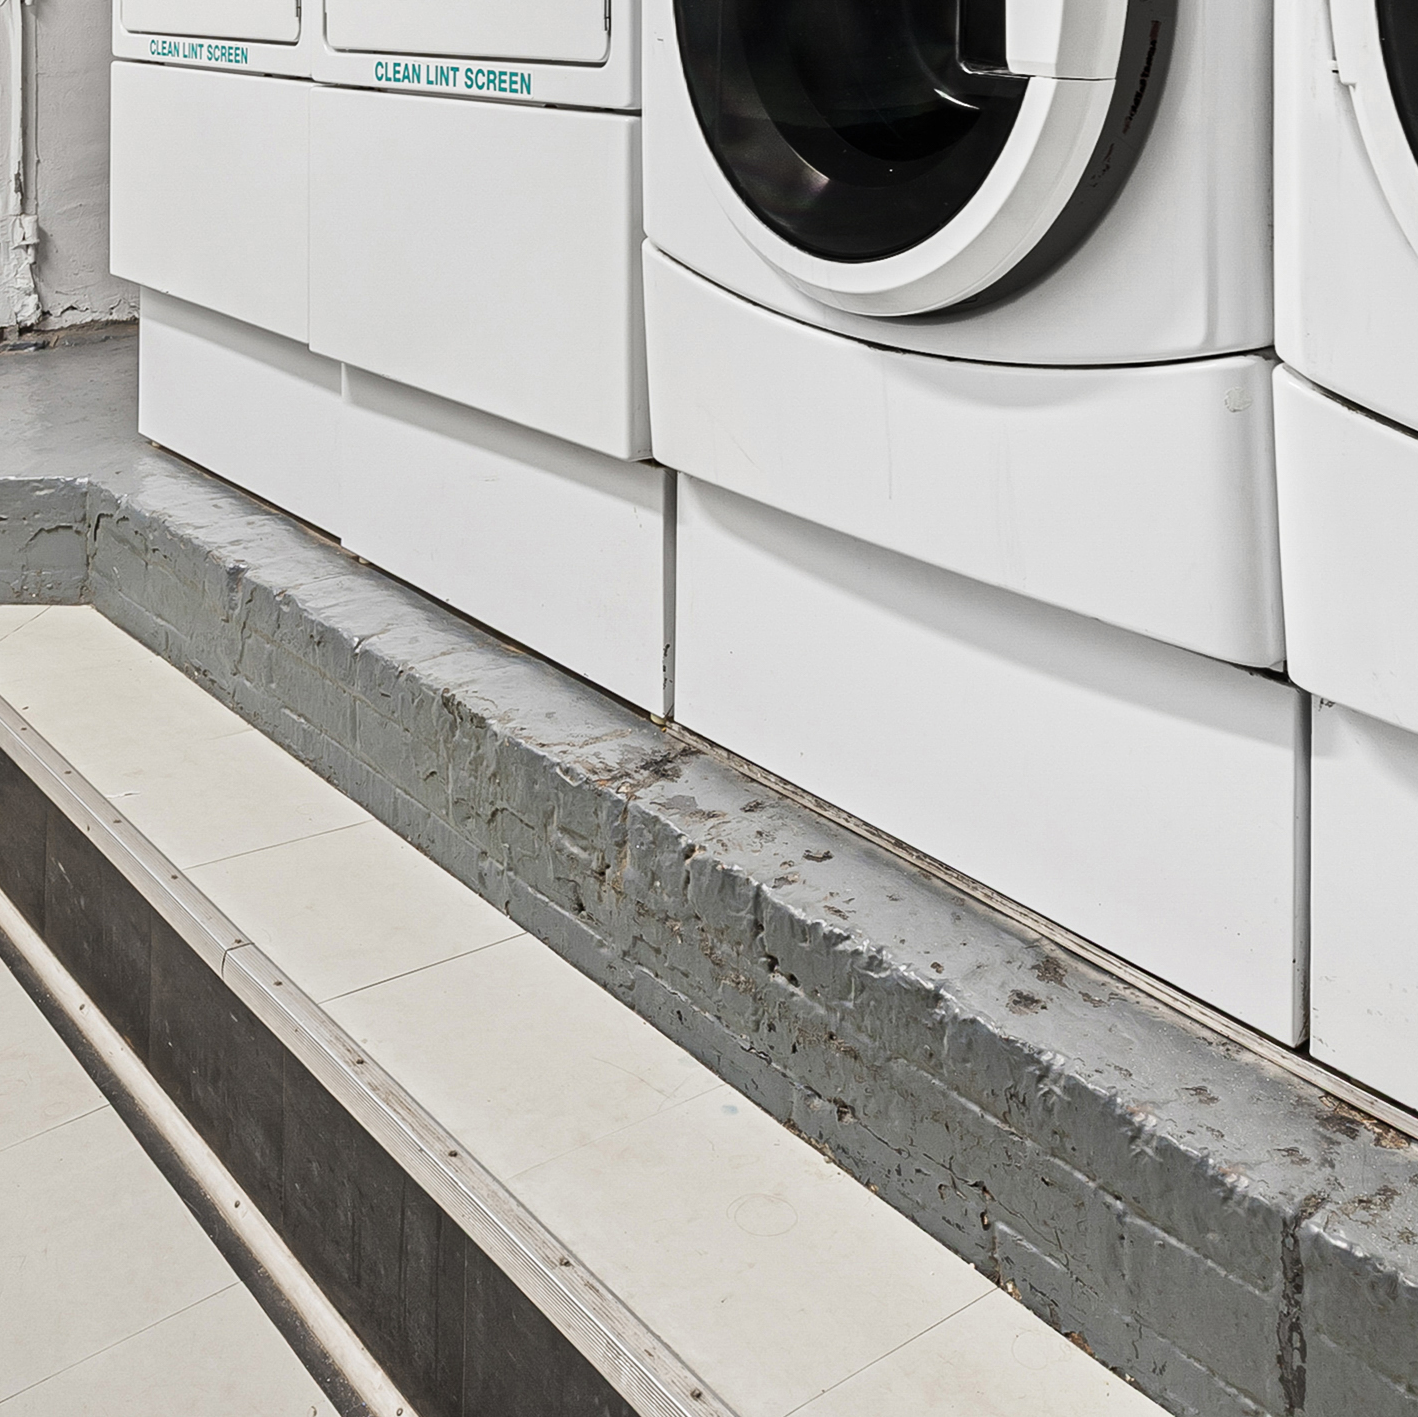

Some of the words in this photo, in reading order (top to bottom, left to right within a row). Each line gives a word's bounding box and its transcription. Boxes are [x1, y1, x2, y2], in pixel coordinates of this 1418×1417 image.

[149, 39, 180, 57] CLEAN
[183, 43, 204, 60] LINT
[206, 46, 249, 65] SCREEN
[374, 61, 421, 84] CLEAN
[426, 65, 459, 87] LINT
[464, 68, 532, 95] SCREEN
